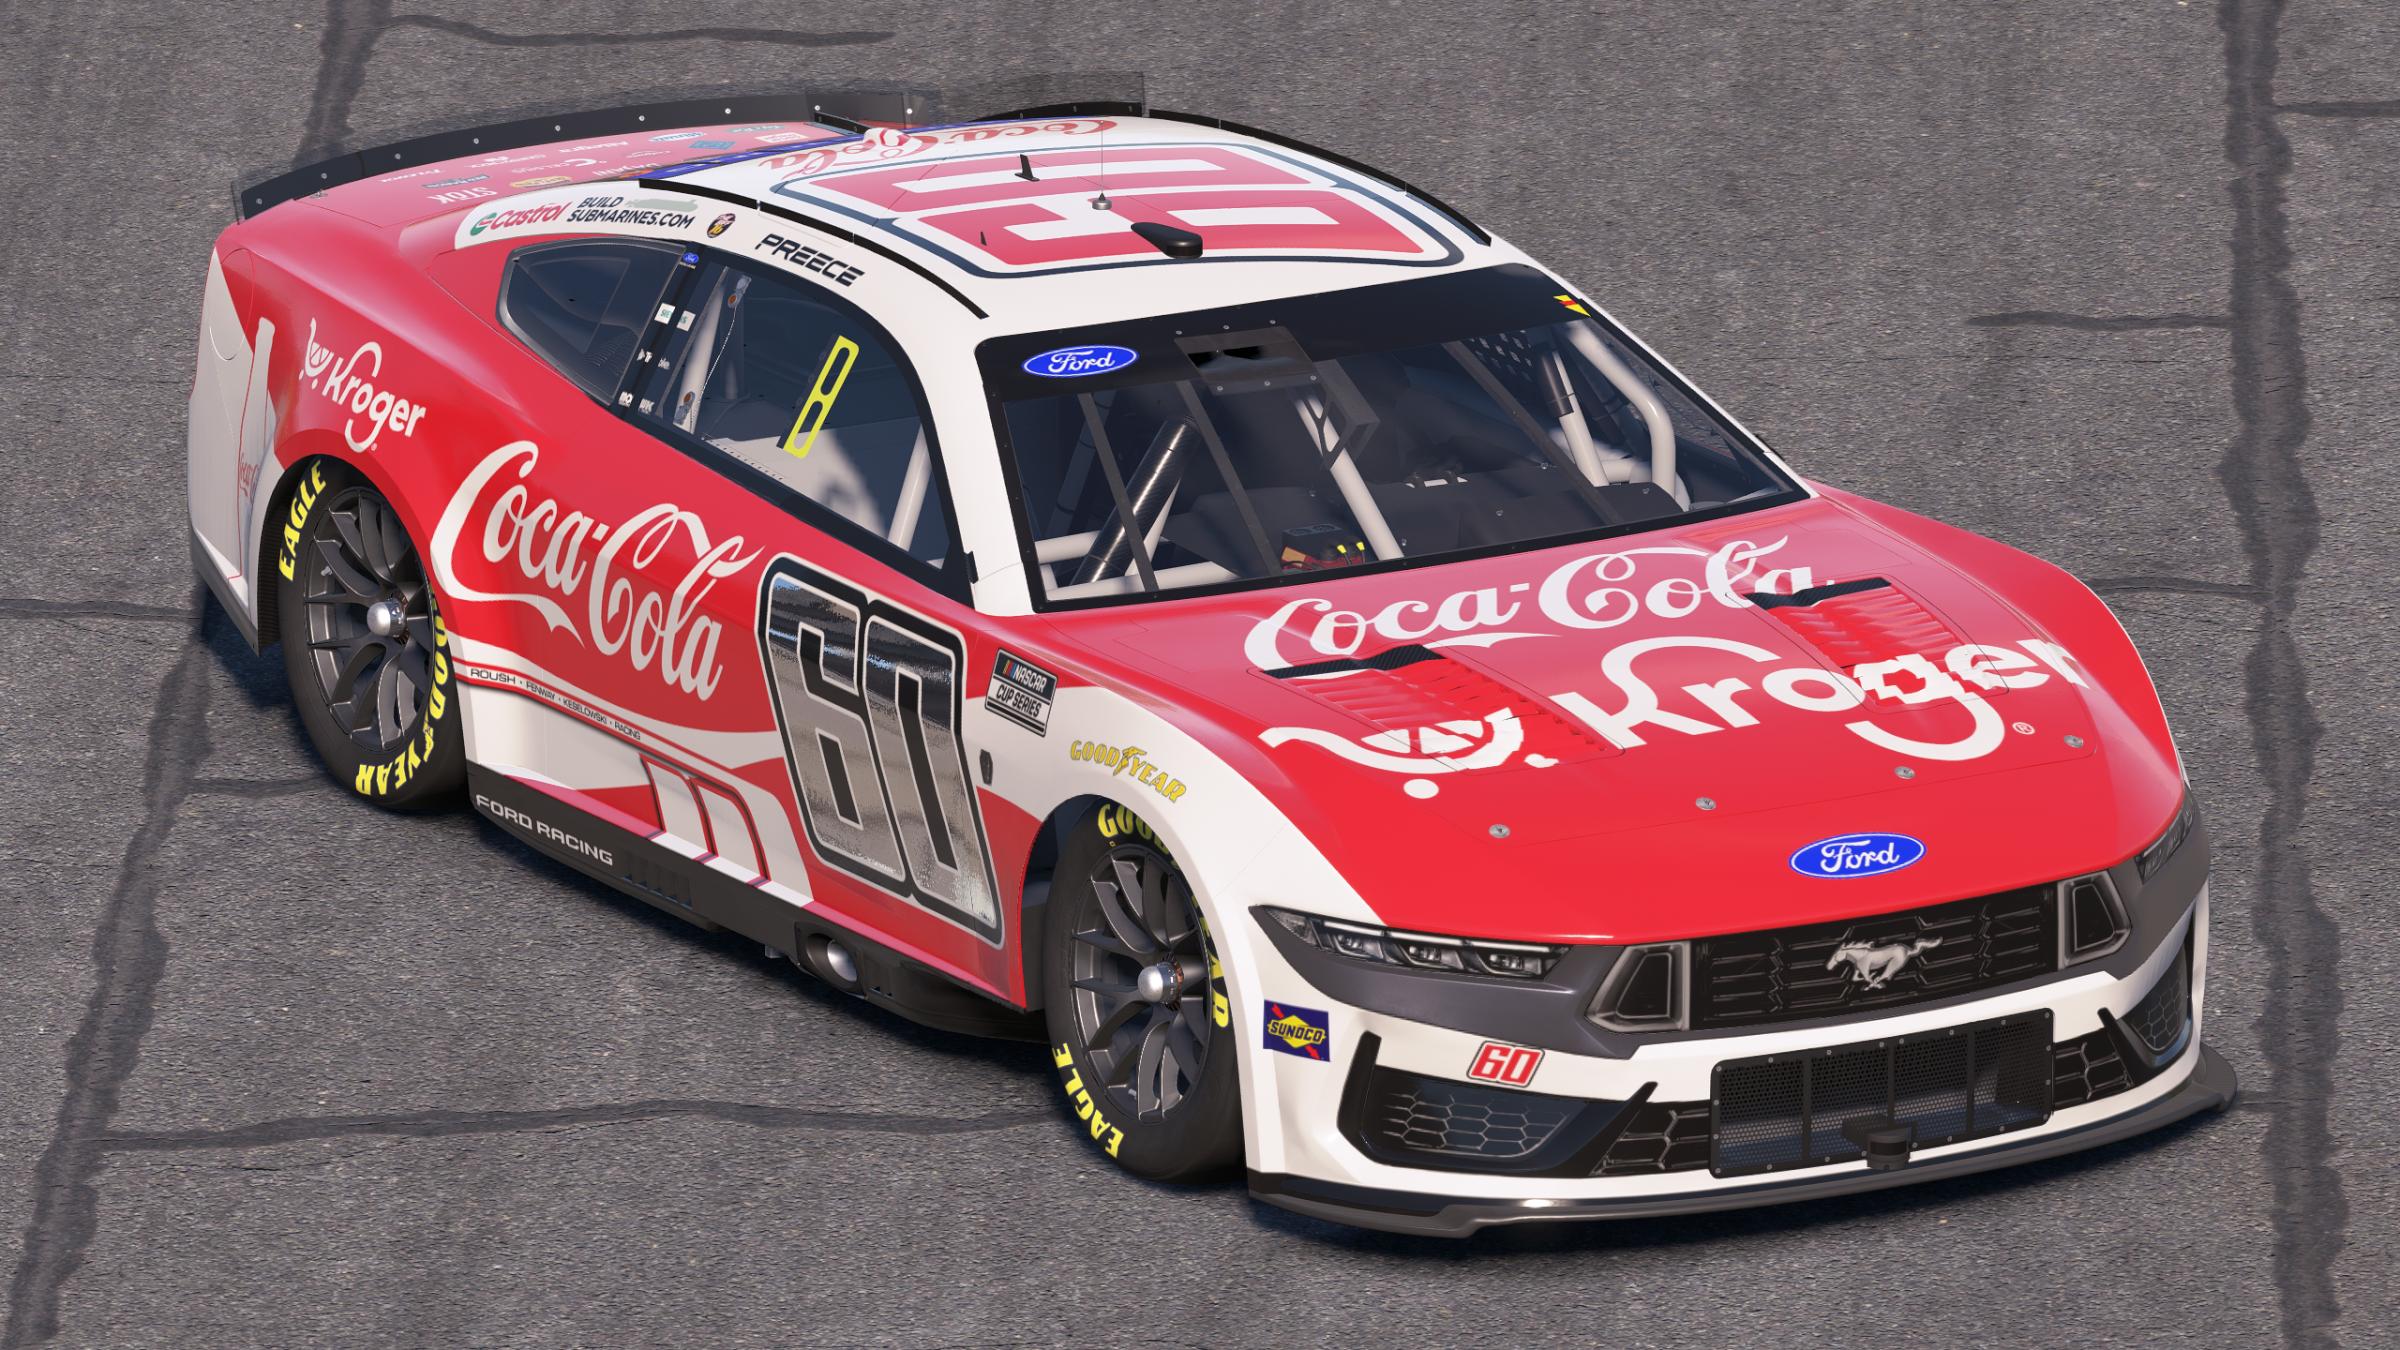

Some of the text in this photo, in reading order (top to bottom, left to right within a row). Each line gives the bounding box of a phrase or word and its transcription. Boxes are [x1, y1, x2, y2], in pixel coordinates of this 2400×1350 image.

[490, 201, 572, 230] Castrol
[566, 209, 696, 230] SUBMARINES.COM
[577, 196, 624, 208] BUILD
[754, 233, 866, 287] PREECE
[1048, 350, 1116, 373] Ford
[322, 341, 427, 453] Kroger
[279, 459, 326, 581] EAGLE
[430, 440, 766, 701] Coca-Cola
[1244, 535, 1834, 677] Coca-Cola
[470, 668, 642, 741] ROUSH FENWAY KESELOWSKI RACING
[996, 684, 1042, 718] CUP SERIES
[1012, 664, 1048, 694] NASCAR
[1552, 636, 2091, 761] Kroger
[756, 552, 1005, 950] 60
[1070, 739, 1188, 803] GOODYEAR
[475, 794, 613, 866] FORD RACING
[1820, 840, 1900, 873] Ford
[1270, 1021, 1323, 1043] SUNOCO
[1471, 1045, 1541, 1084] 60
[1052, 1042, 1124, 1158] EAGLE
